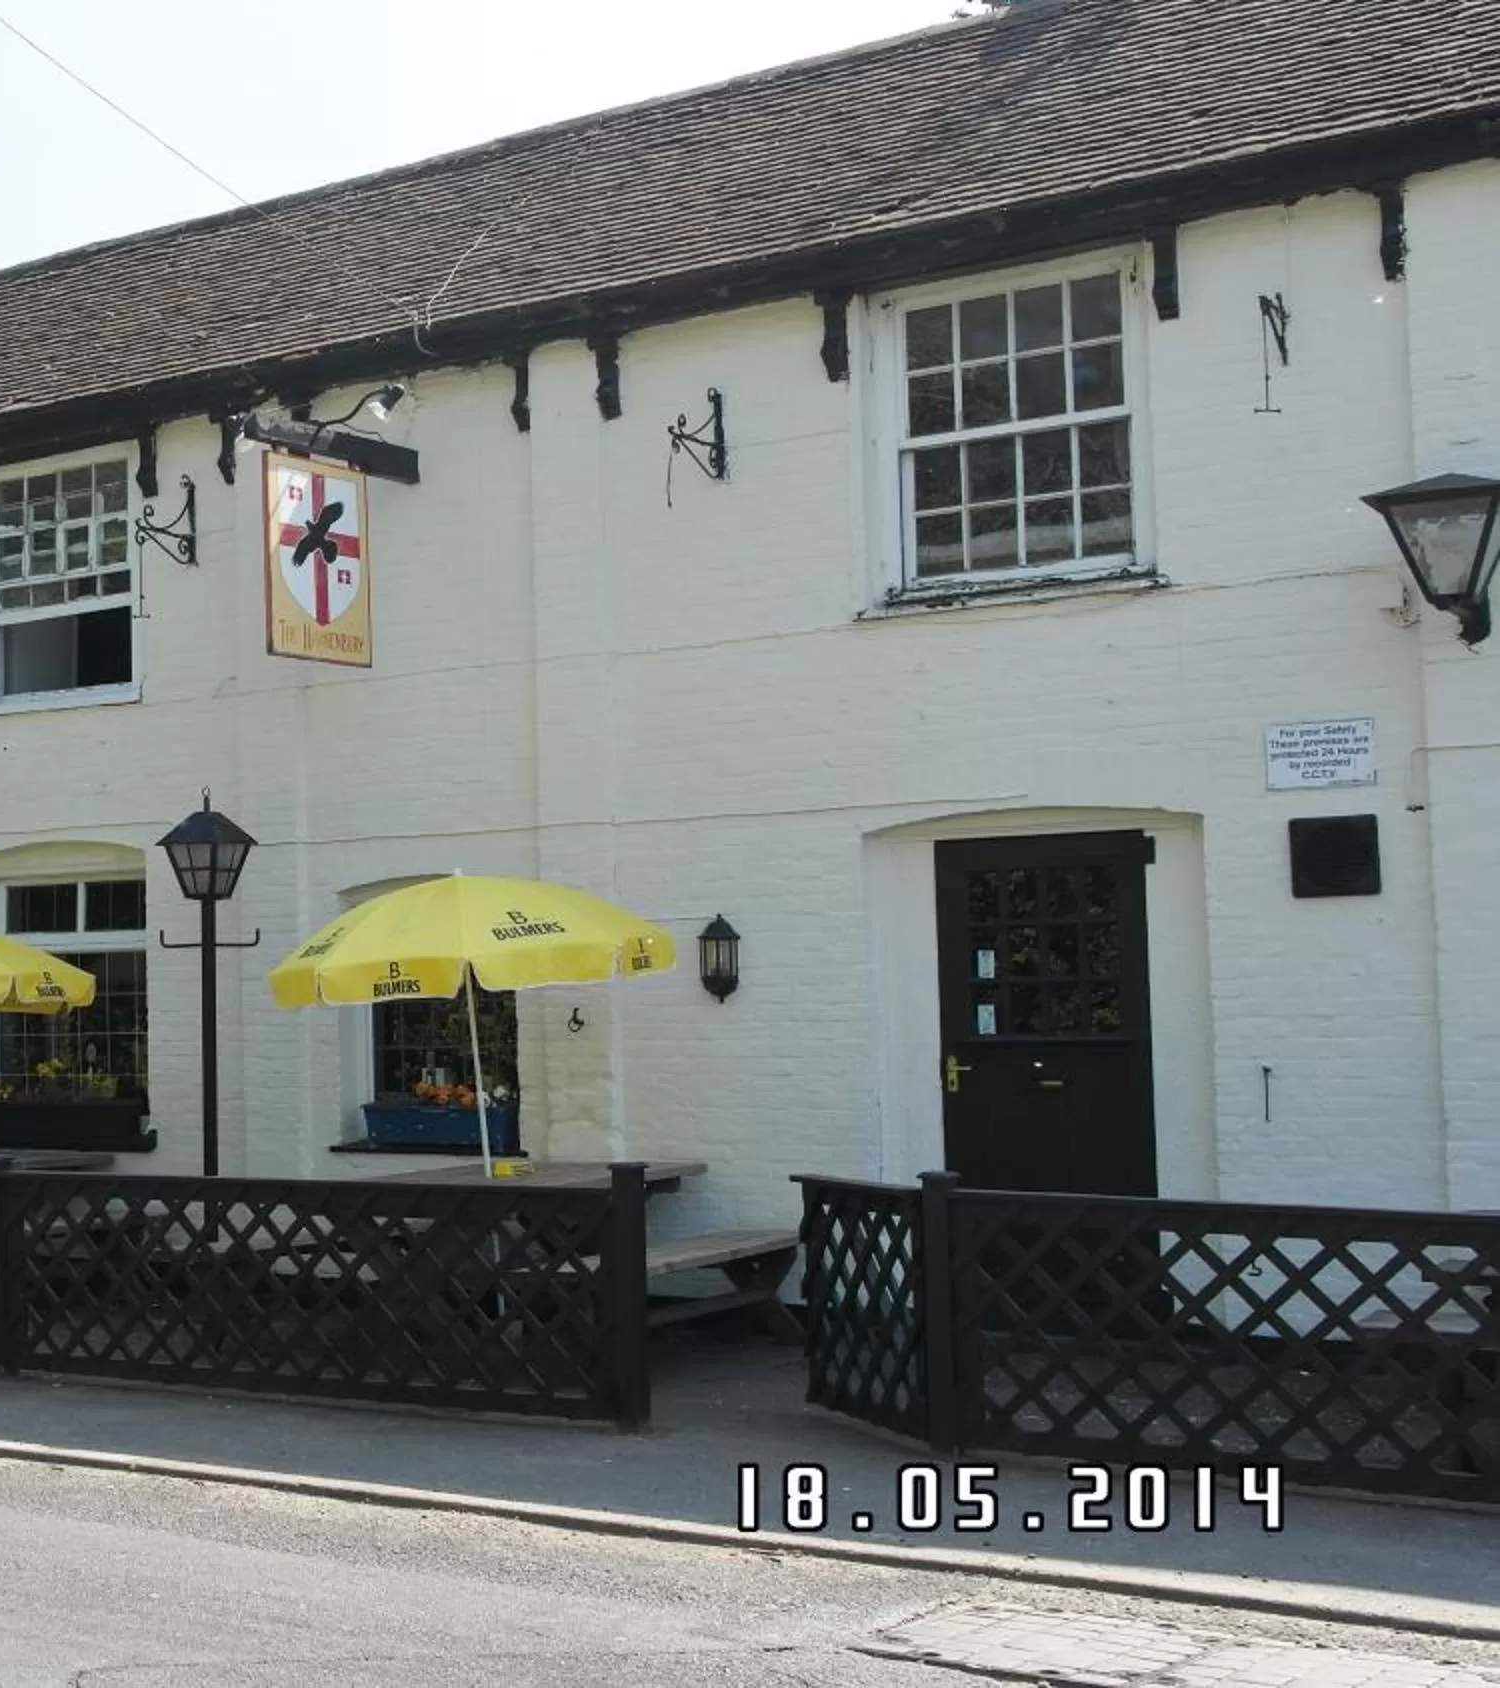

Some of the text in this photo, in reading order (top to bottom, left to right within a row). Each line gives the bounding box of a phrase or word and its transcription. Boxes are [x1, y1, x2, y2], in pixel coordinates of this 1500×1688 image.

[1279, 728, 1295, 738] For
[1323, 723, 1357, 736] Safety
[1338, 745, 1369, 756] Hours
[507, 910, 528, 925] B
[492, 922, 566, 941] BULMERS
[389, 961, 402, 979] B
[373, 979, 421, 997] BULMERS
